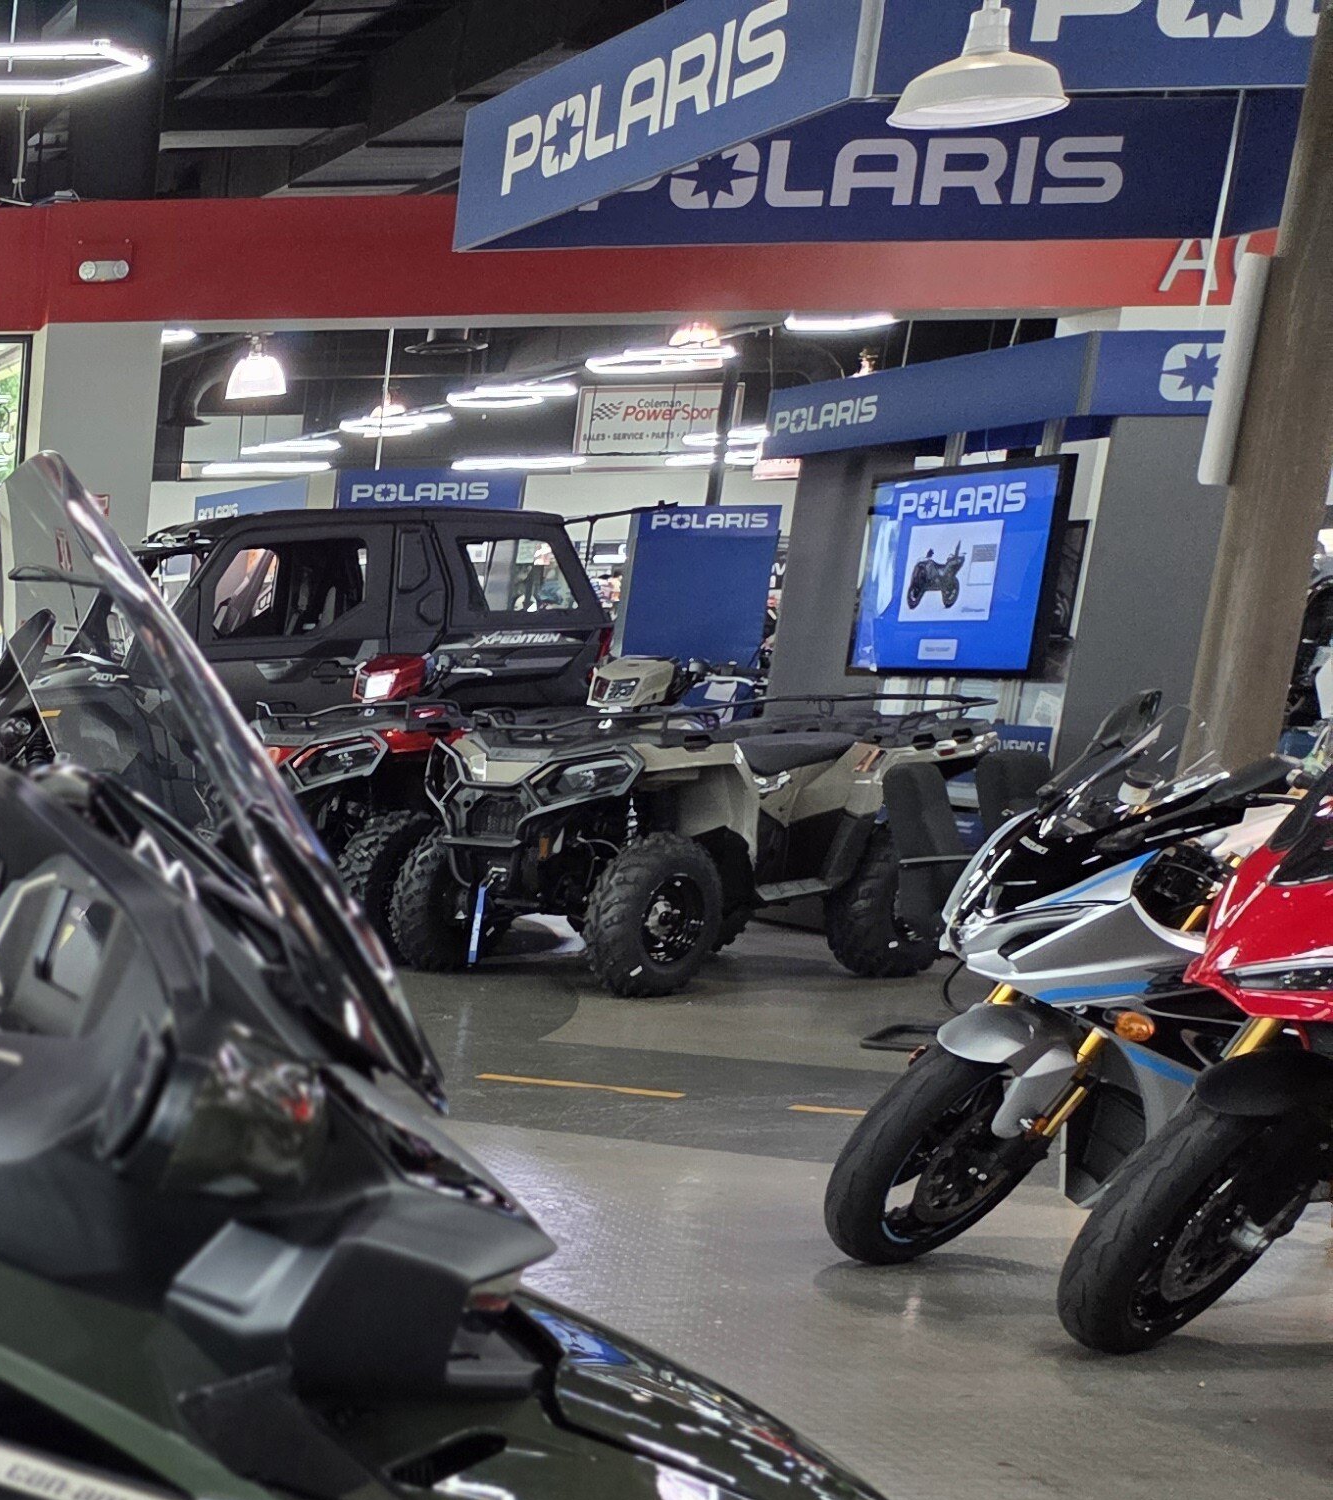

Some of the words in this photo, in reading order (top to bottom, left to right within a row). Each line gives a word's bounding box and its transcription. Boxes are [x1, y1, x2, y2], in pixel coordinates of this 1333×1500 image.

[500, 0, 788, 196] POLARIS
[578, 136, 1125, 211] OLARIS
[622, 403, 723, 422] PowerSpor
[637, 398, 682, 408] Coleman
[773, 395, 878, 437] POLARIS
[612, 431, 645, 441] SERVICE
[351, 482, 489, 503] POLARIS
[897, 481, 1027, 521] POLARIS
[651, 512, 768, 530] POLARIS
[471, 630, 561, 648] XPEDITION
[88, 672, 119, 682] ADV
